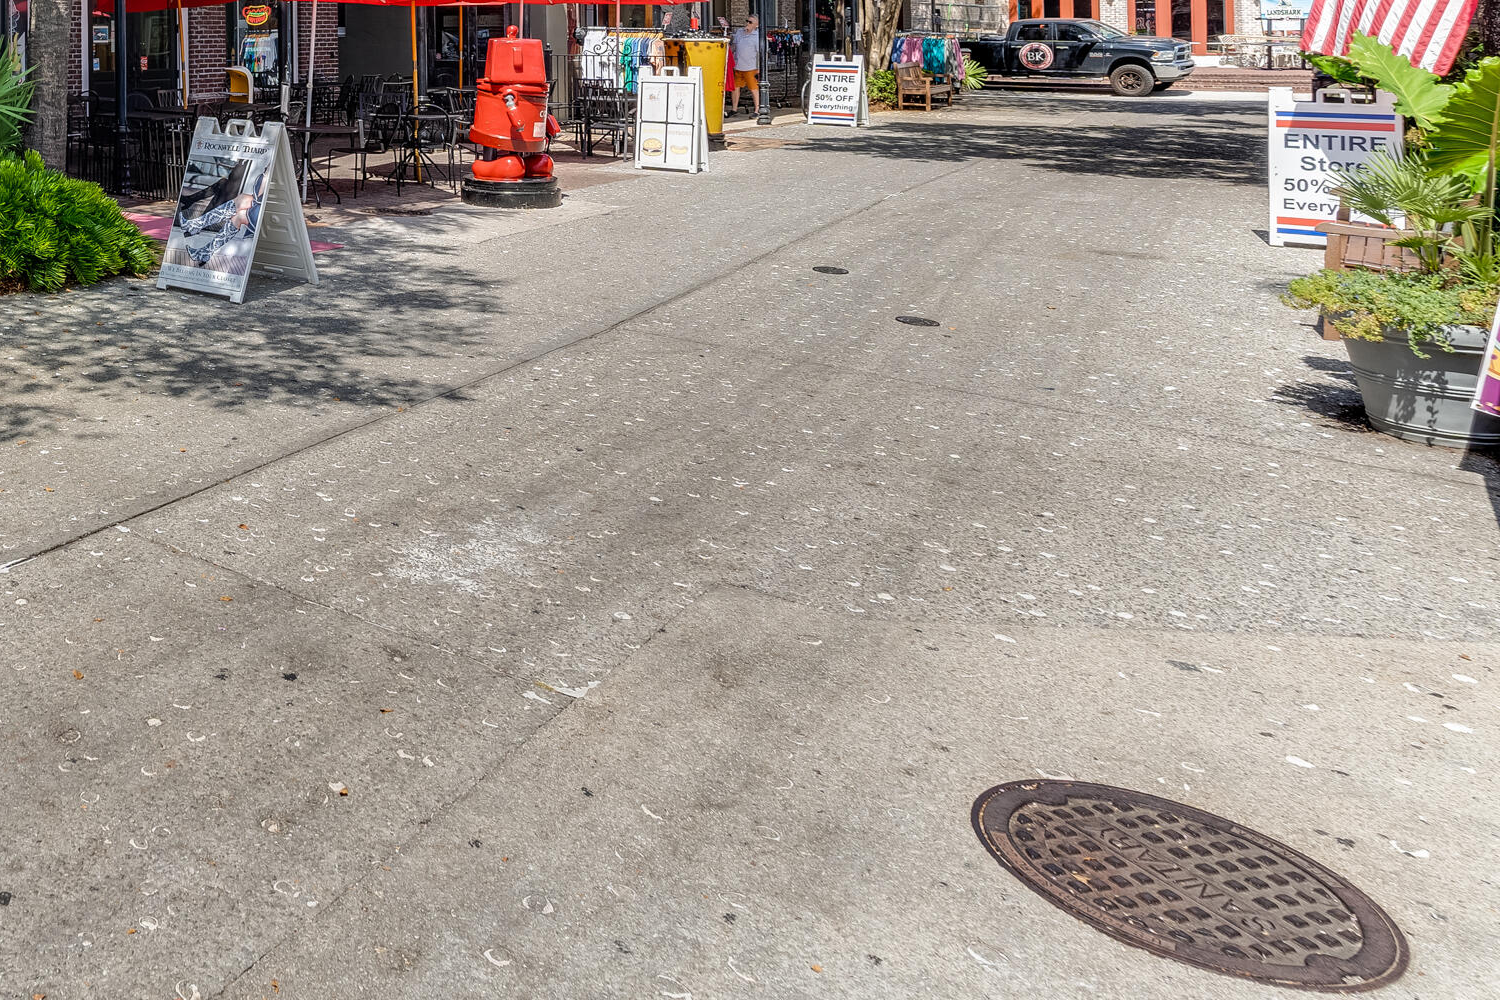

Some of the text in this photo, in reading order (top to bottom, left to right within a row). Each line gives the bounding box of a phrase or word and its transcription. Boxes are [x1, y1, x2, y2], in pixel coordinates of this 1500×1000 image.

[1027, 51, 1045, 61] BK
[817, 74, 855, 83] ENTIRE
[822, 84, 848, 92] Store
[815, 94, 854, 102] 50% OFF
[814, 102, 854, 112] Everything
[1283, 133, 1387, 153] ENTIRE
[204, 142, 268, 155] ROCKWELL THARP
[1283, 178, 1332, 194] 50%
[1097, 826, 1276, 936] SANITARY
